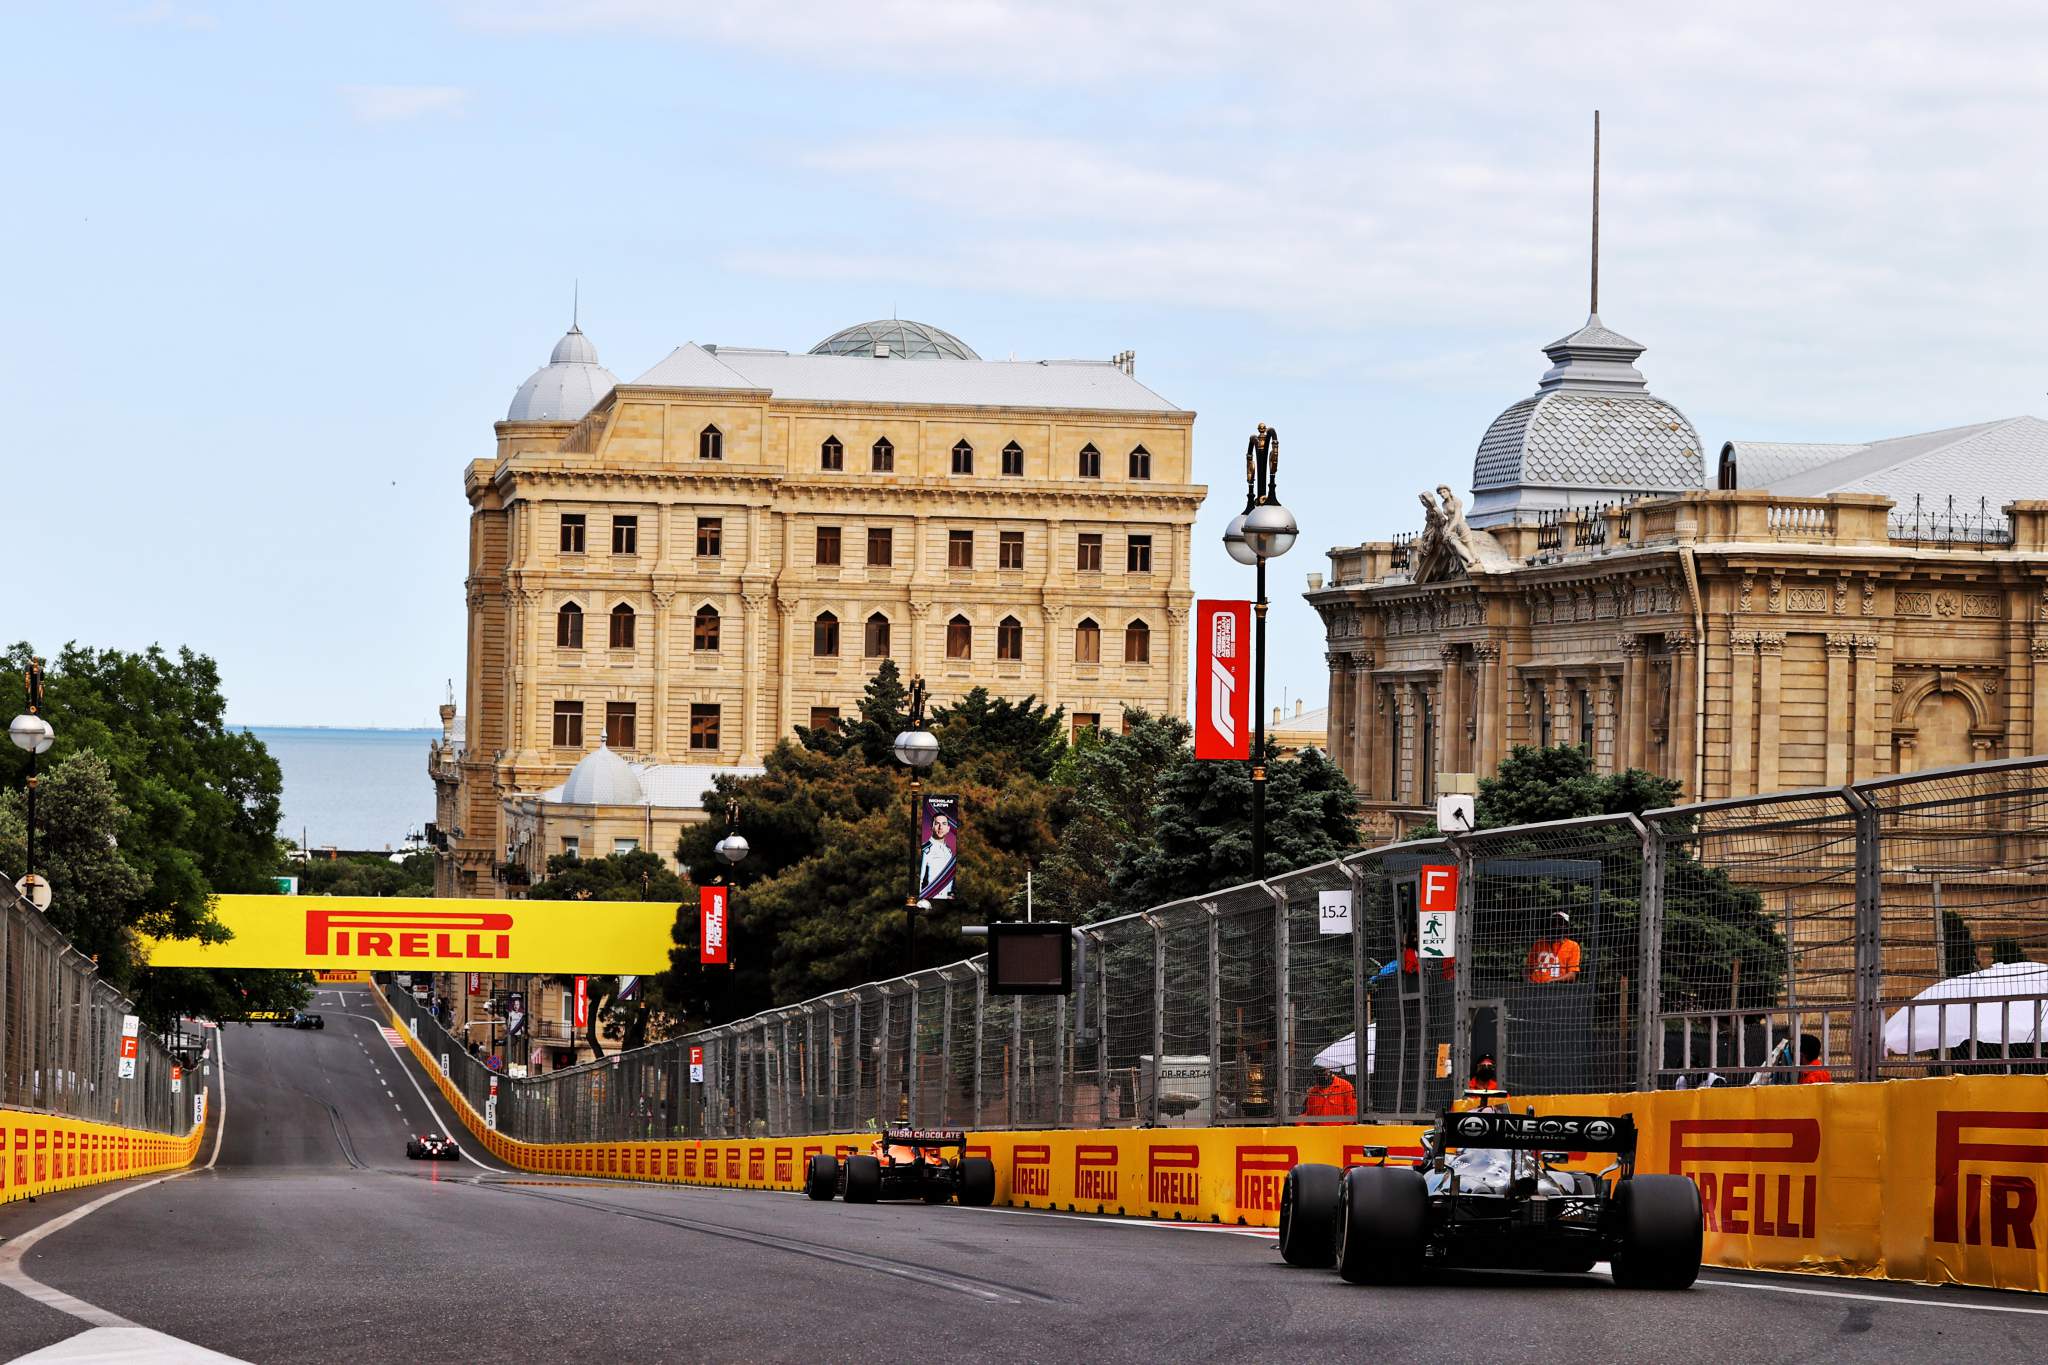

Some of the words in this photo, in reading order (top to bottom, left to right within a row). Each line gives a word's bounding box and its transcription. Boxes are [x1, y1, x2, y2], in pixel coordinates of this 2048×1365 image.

[1425, 871, 1449, 905] F
[1321, 905, 1347, 918] 15.2
[306, 910, 514, 959] PIRELLI
[124, 1040, 136, 1056] F
[691, 1049, 700, 1063] F
[172, 1067, 179, 1078] F
[1495, 1117, 1580, 1134] INEOS
[888, 1130, 912, 1139] HUSKI
[914, 1130, 961, 1140] CHOCOLATE
[1012, 1145, 1050, 1196] PIRELLI
[1075, 1145, 1118, 1200] PIRELLI
[1148, 1145, 1199, 1206] PIRELLI
